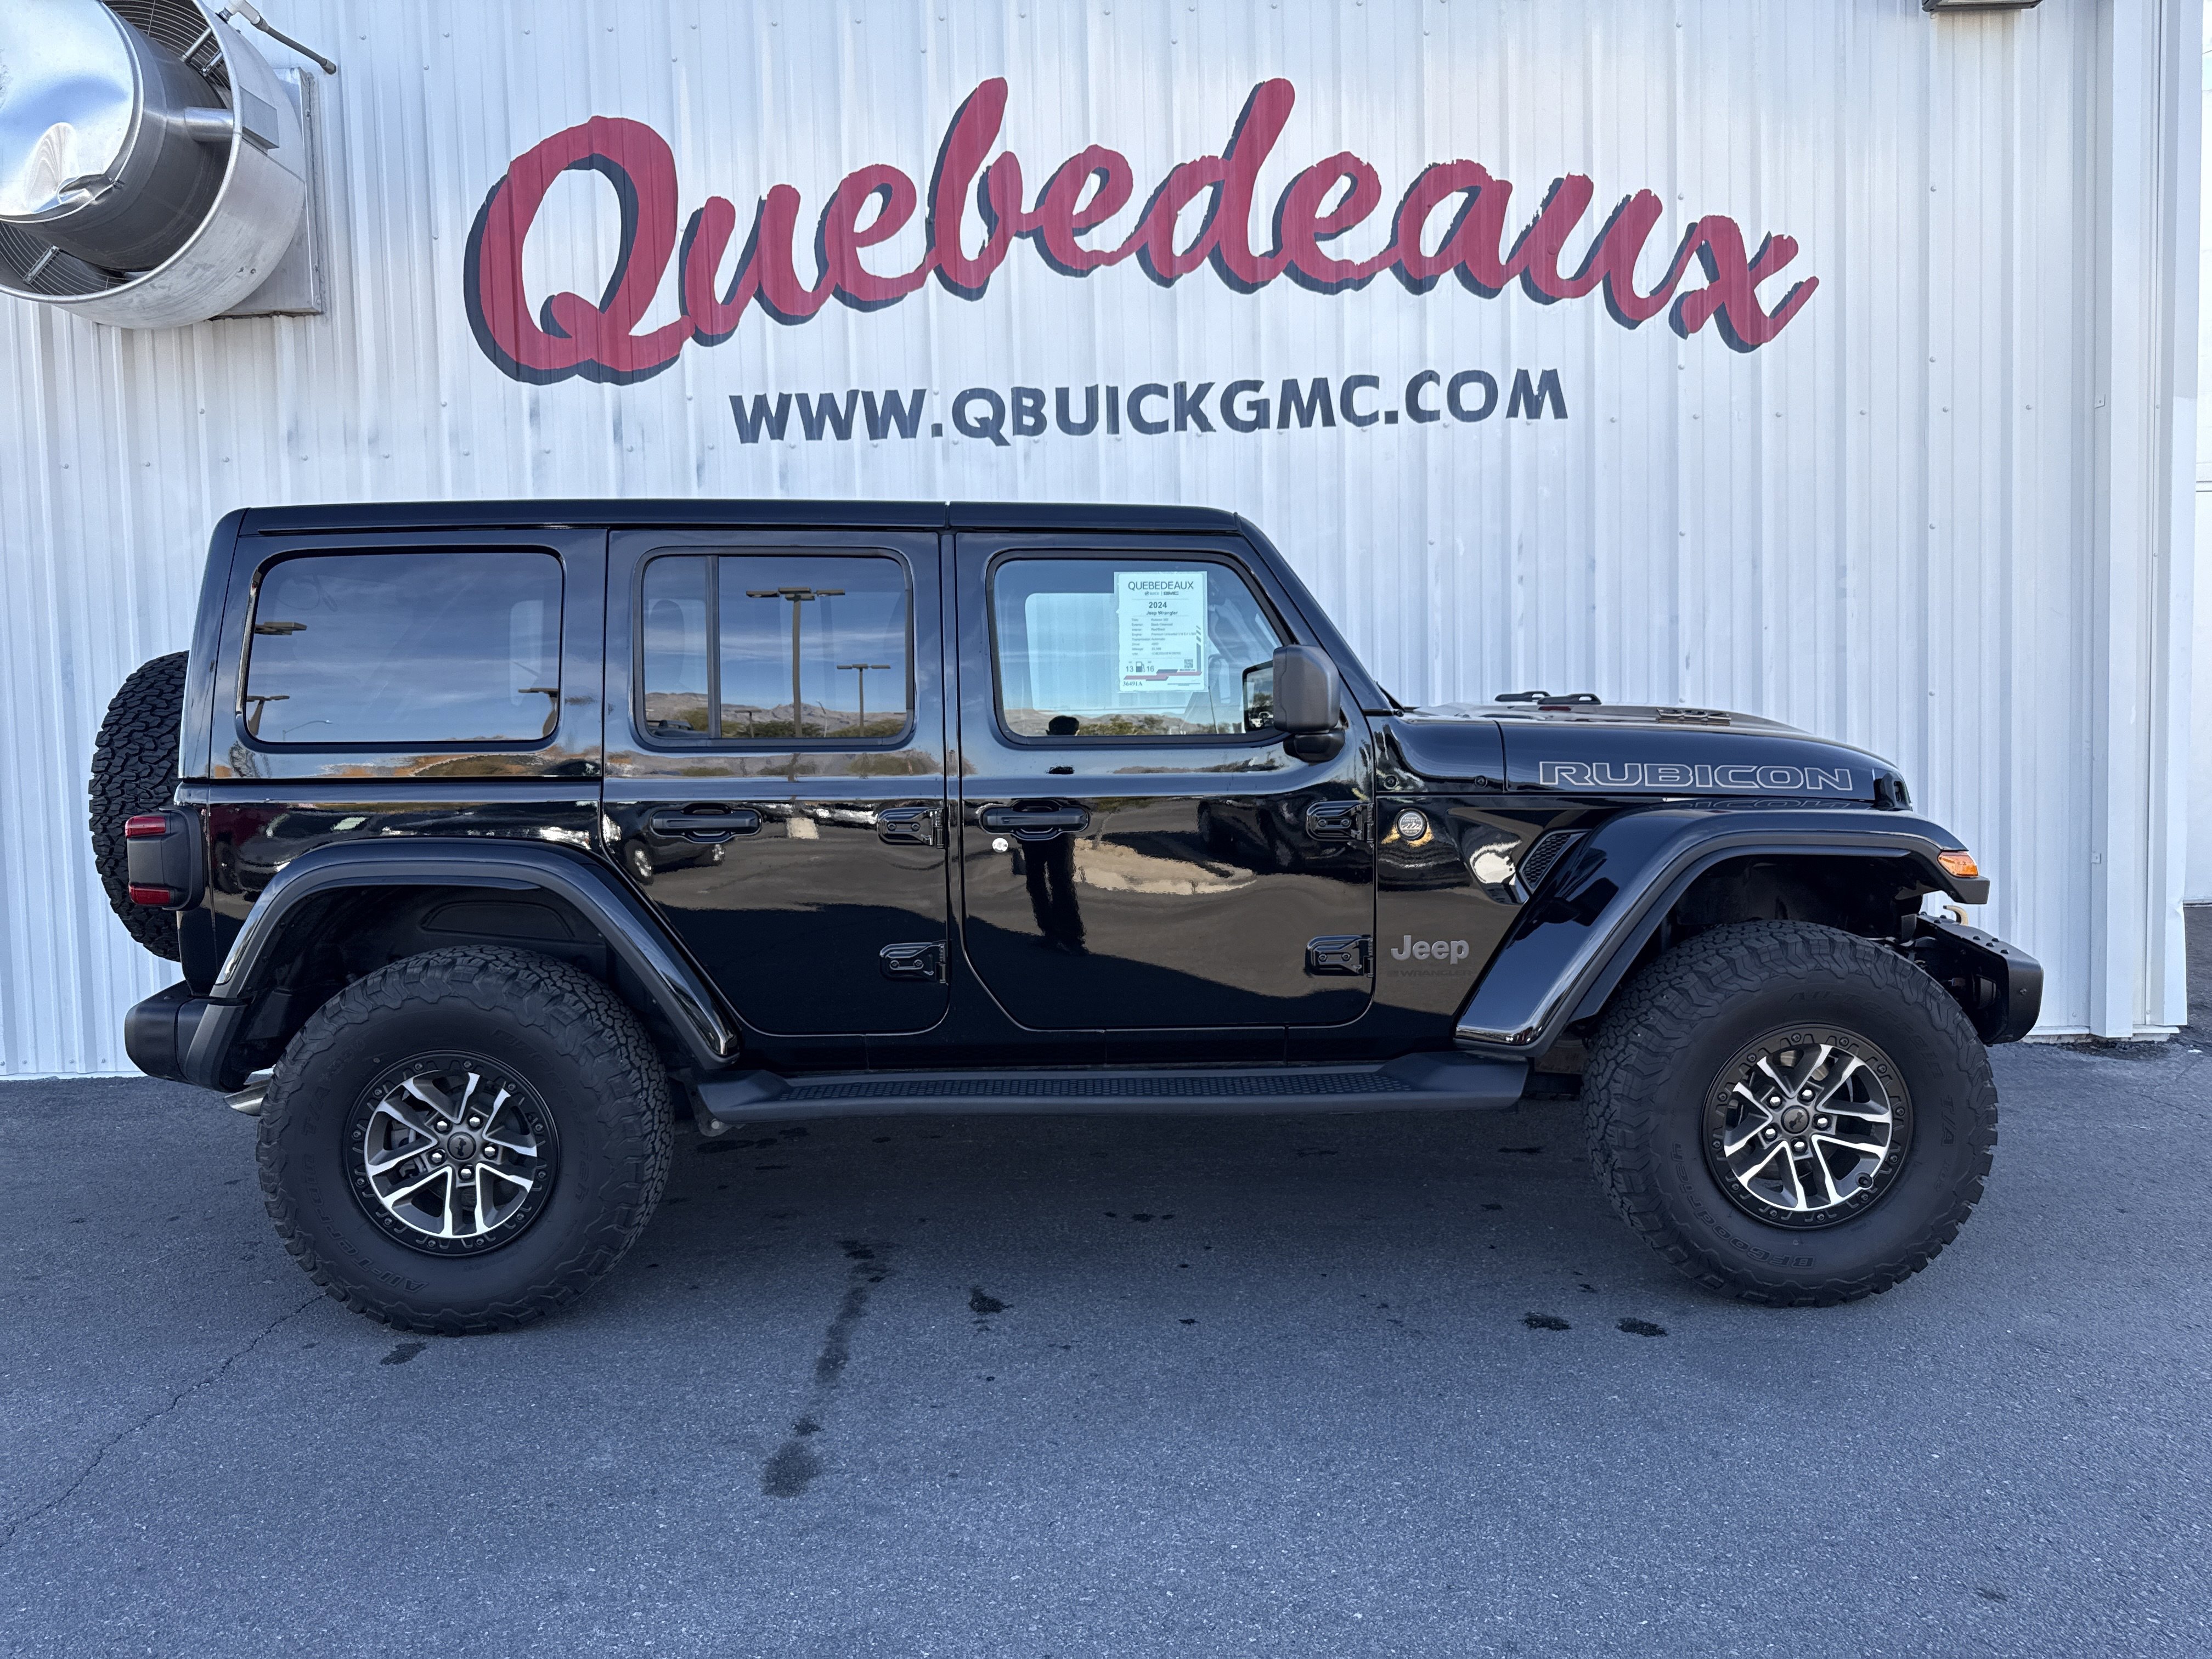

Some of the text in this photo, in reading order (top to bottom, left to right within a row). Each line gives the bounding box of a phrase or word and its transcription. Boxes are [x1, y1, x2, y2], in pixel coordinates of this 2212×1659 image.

[464, 77, 1819, 385] Quebedeaux
[729, 368, 1568, 446] WWW.QBUICKGMC.COM
[1128, 581, 1194, 591] QUEBEDEAUX
[1539, 761, 1854, 792] RUBICON
[1390, 935, 1470, 965] Jeep
